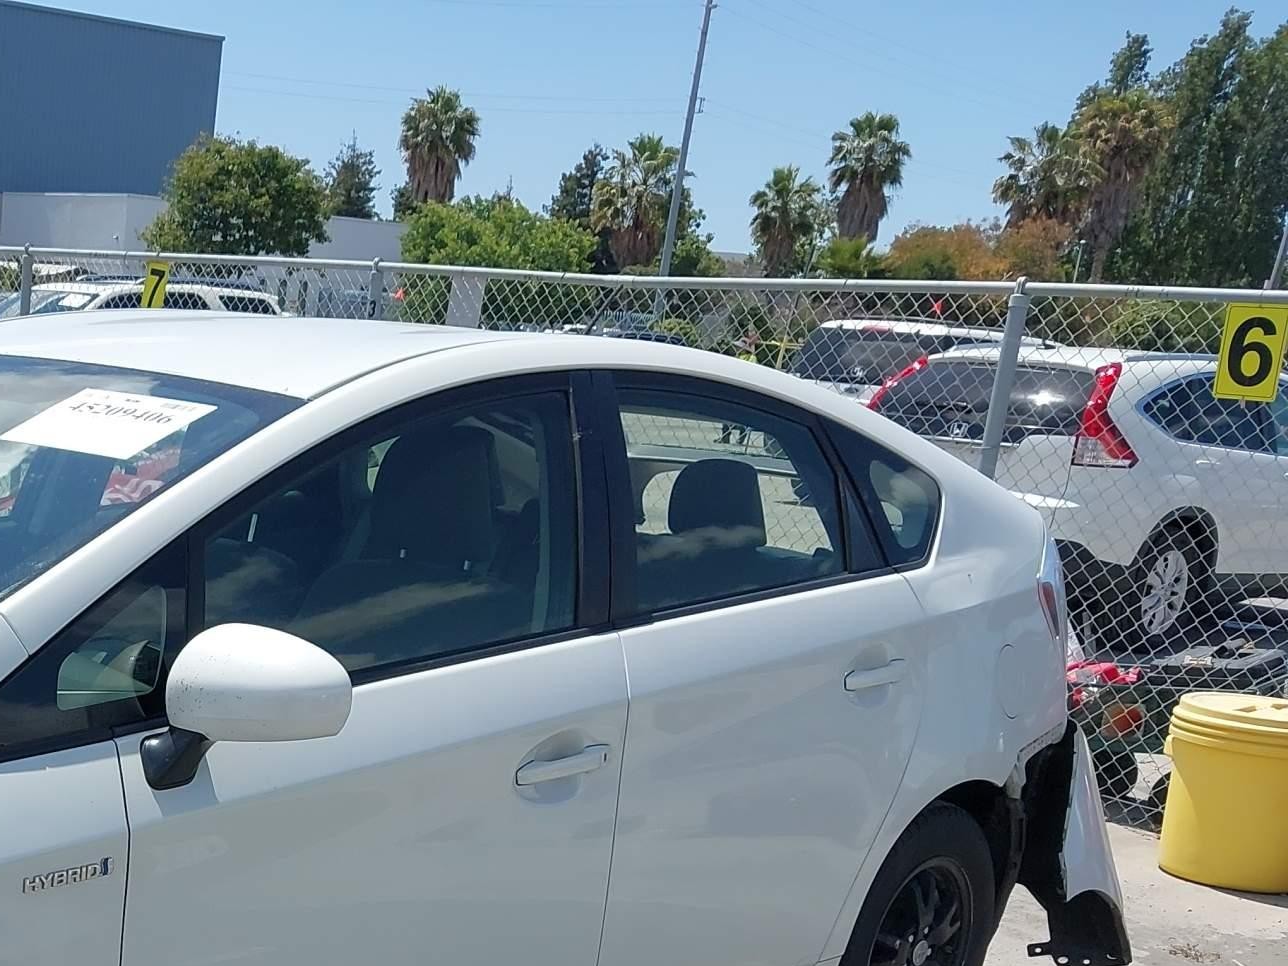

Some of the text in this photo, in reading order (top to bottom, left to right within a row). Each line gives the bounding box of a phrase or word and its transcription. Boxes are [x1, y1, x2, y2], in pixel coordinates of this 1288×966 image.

[147, 267, 166, 308] 7
[1228, 316, 1278, 387] 6
[22, 862, 100, 894] HYBRID
